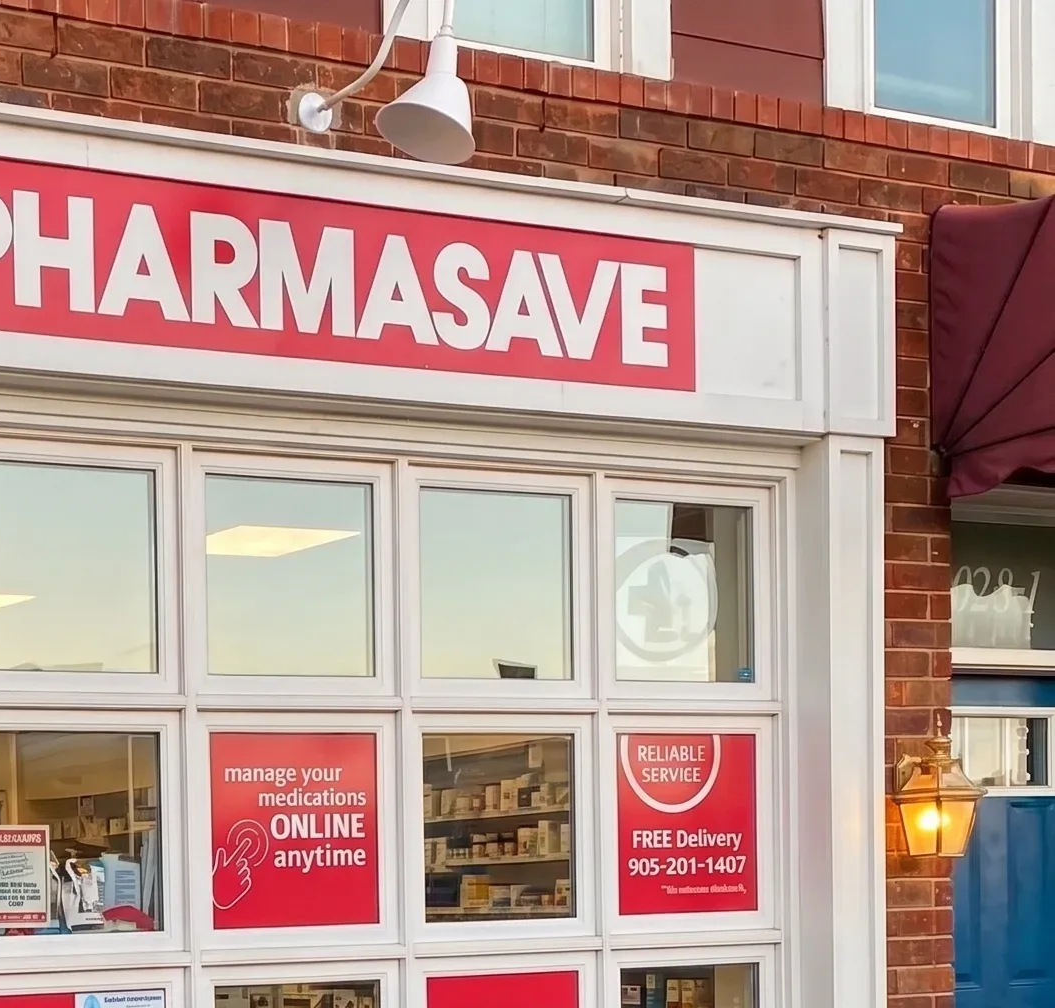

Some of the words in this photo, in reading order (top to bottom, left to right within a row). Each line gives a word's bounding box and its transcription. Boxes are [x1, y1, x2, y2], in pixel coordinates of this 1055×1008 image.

[637, 745, 706, 762] RELIABLE
[224, 767, 297, 787] manage
[301, 767, 343, 787] your
[641, 767, 702, 783] SERVICE
[258, 788, 367, 807] medications
[270, 813, 366, 840] ONLINE
[632, 830, 673, 849] FREE
[677, 828, 743, 851] Delivery
[273, 844, 367, 873] anytime
[628, 856, 747, 876] 905-201-1407
